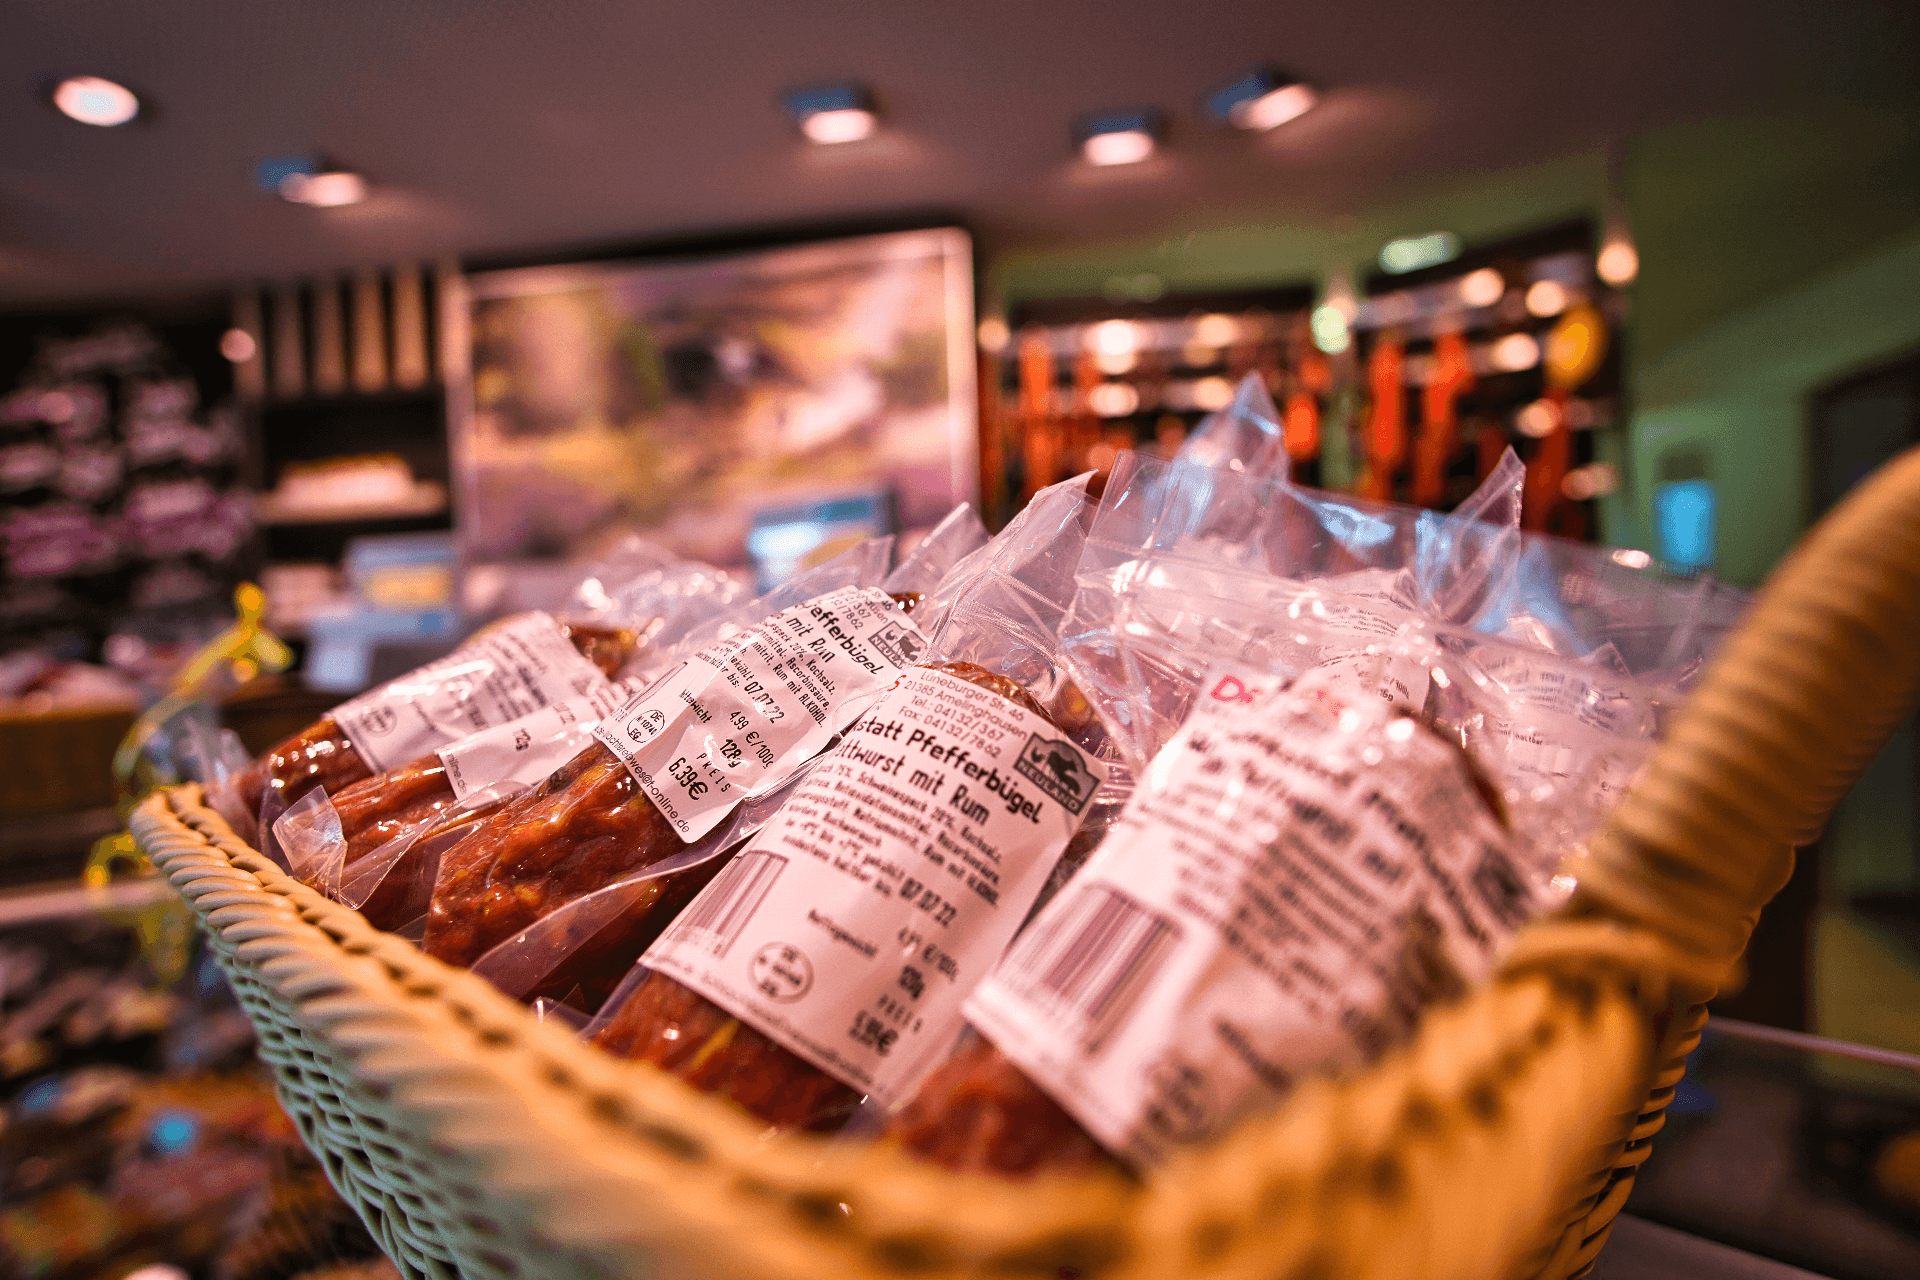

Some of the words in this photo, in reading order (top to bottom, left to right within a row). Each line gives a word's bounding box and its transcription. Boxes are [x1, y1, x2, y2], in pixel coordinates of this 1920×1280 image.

[786, 617, 814, 638] mit
[668, 757, 709, 801] 6,39€
[905, 727, 1043, 824] Pfefferbügel
[908, 767, 947, 797] mit
[948, 783, 991, 827] Rum
